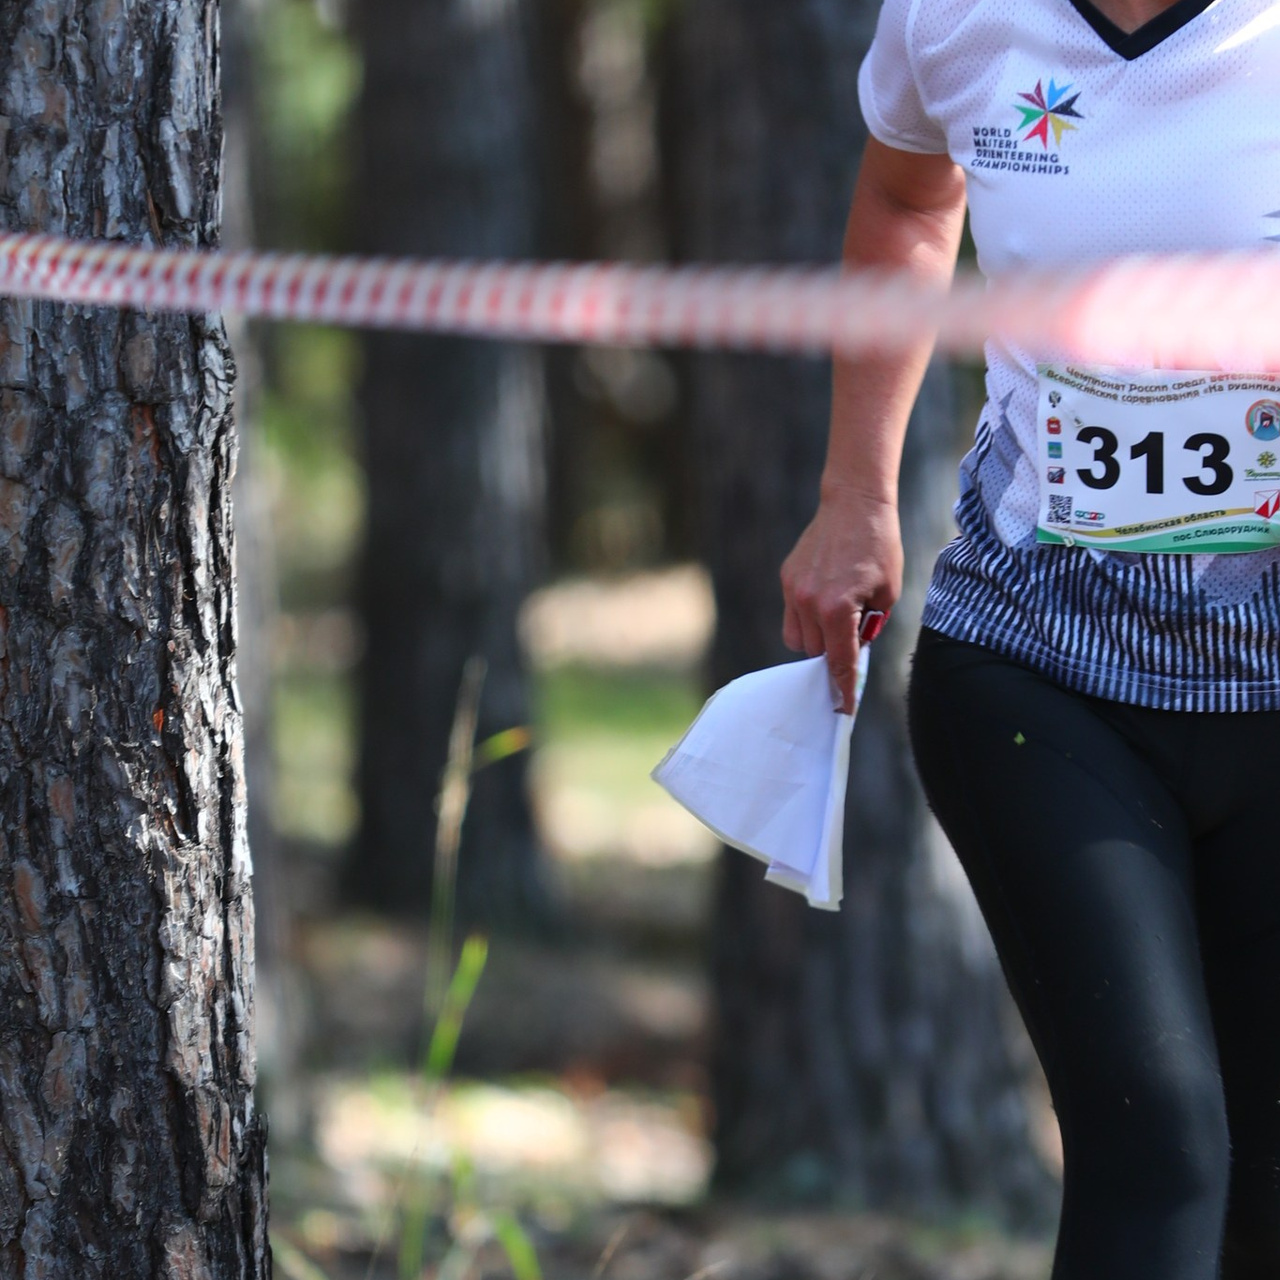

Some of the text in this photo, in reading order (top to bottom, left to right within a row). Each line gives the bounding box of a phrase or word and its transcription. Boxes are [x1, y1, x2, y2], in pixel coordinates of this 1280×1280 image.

[973, 127, 1011, 137] WORLD
[973, 138, 1018, 149] MASTERS
[976, 149, 1059, 163] ORIENTEERING
[971, 159, 1069, 175] CHAMPIONSHIPS
[1076, 425, 1234, 496] 313
[1114, 517, 1182, 536] Челябинская
[1183, 509, 1227, 524] область
